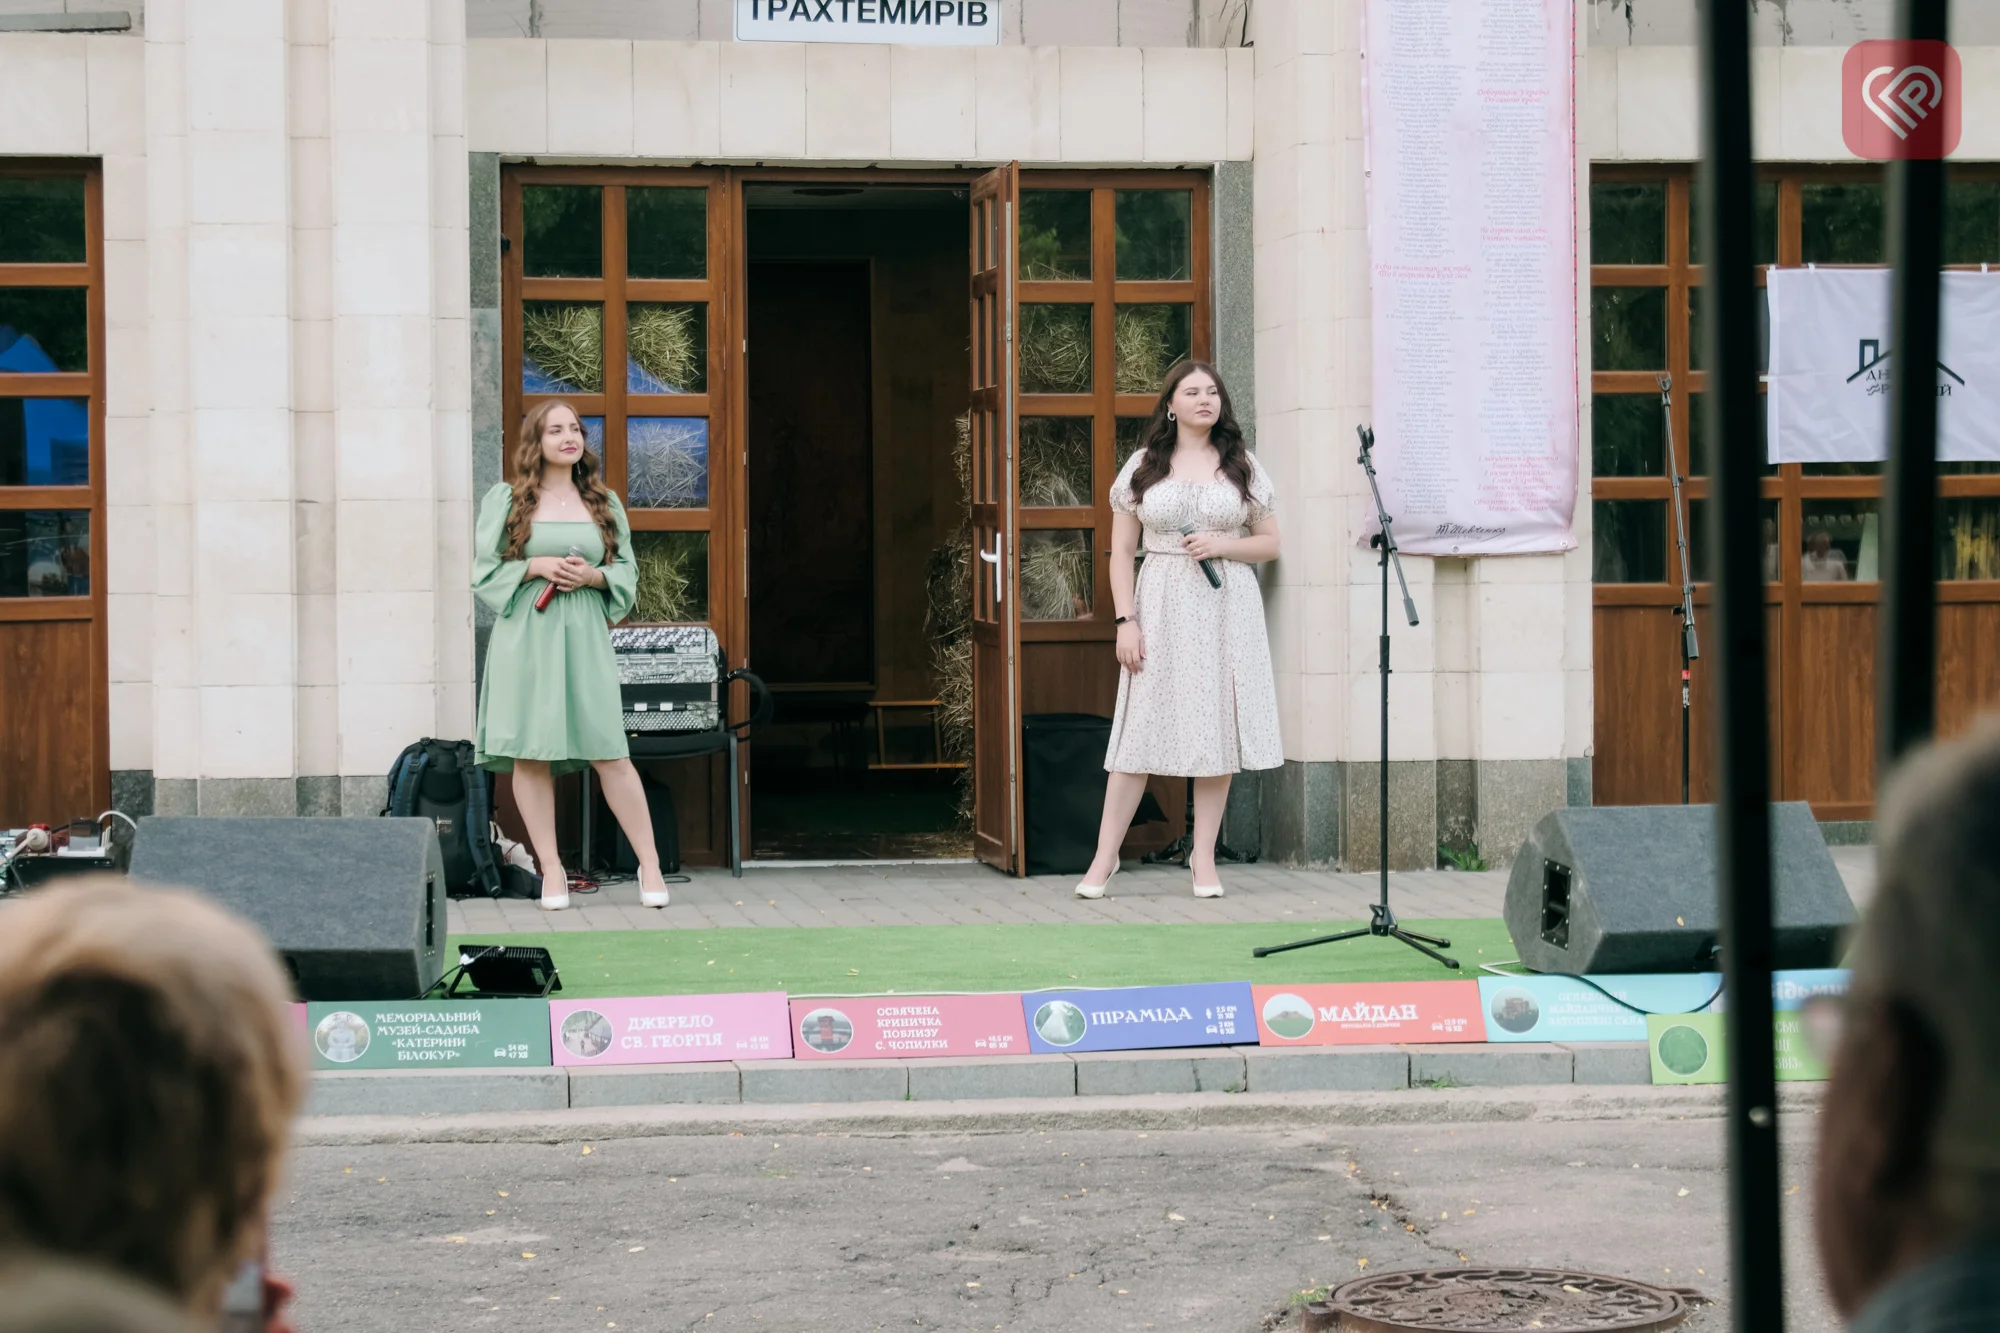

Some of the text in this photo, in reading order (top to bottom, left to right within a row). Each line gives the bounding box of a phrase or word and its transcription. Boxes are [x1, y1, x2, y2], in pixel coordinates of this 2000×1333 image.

[751, 0, 988, 26] ТРАХТЕМИРІВ
[375, 1008, 482, 1023] МЕМОРІАЛЬНИЙ
[876, 1006, 940, 1017] ОСВЯЧЕНА
[1090, 1007, 1193, 1026] ПІРАМІДА
[1318, 1002, 1419, 1023] МАЙДАН
[627, 1015, 714, 1031] ДЖЕРЕЛО
[876, 1017, 943, 1028] КРИНИЧКА
[376, 1024, 480, 1037] МУЗЕЙ-САДИБА
[882, 1028, 939, 1040] ПОБЛИЗУ
[391, 1038, 466, 1049] «КАТЕРИНИ
[621, 1033, 723, 1049] СВ. ГЕОРГІЯ
[875, 1039, 948, 1051] С. ЧОПИЛКИ
[397, 1050, 461, 1062] БІЛОКУР»
